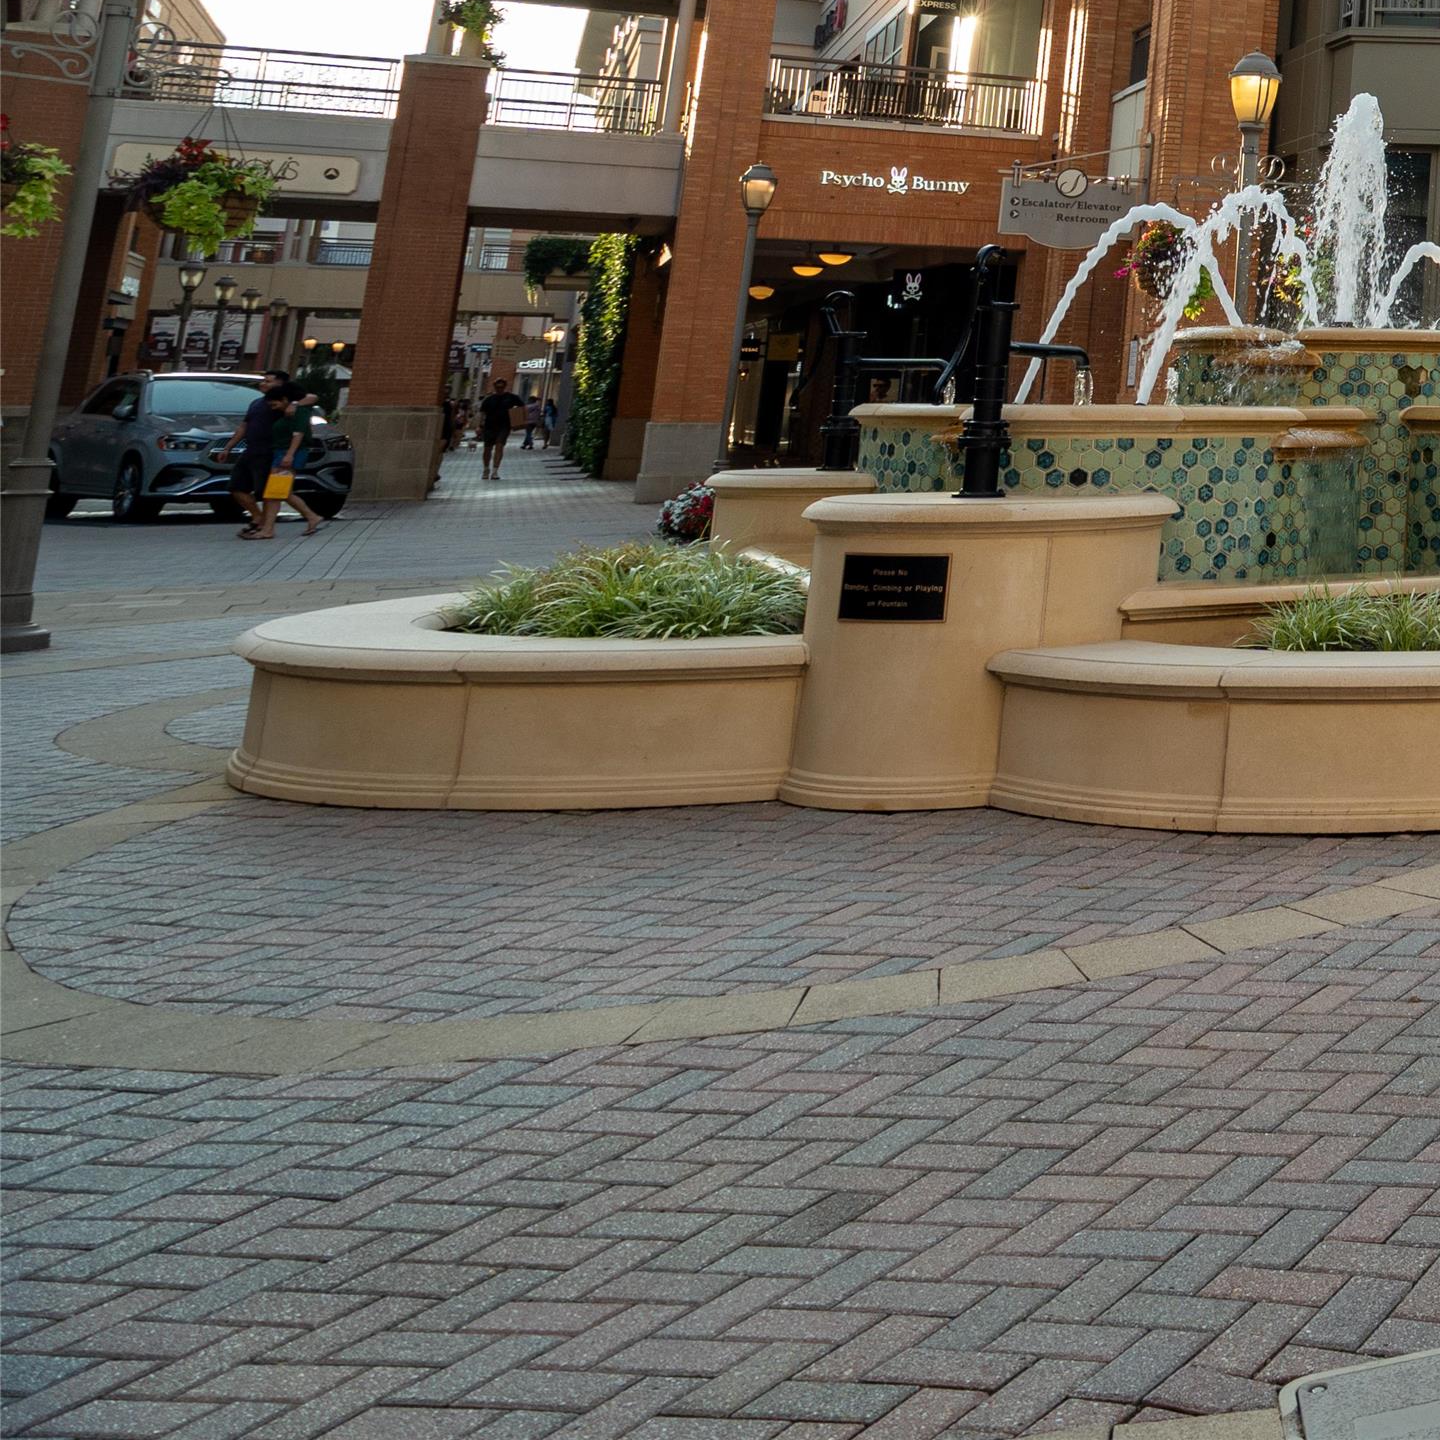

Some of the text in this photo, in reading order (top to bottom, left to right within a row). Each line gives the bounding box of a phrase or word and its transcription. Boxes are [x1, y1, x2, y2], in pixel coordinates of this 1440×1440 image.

[916, 0, 957, 10] EXPRESS
[821, 170, 970, 195] Psycho Bunny
[1022, 197, 1122, 212] Escalator/Elevator
[1056, 213, 1109, 225] Restroom
[915, 585, 944, 593] Playing
